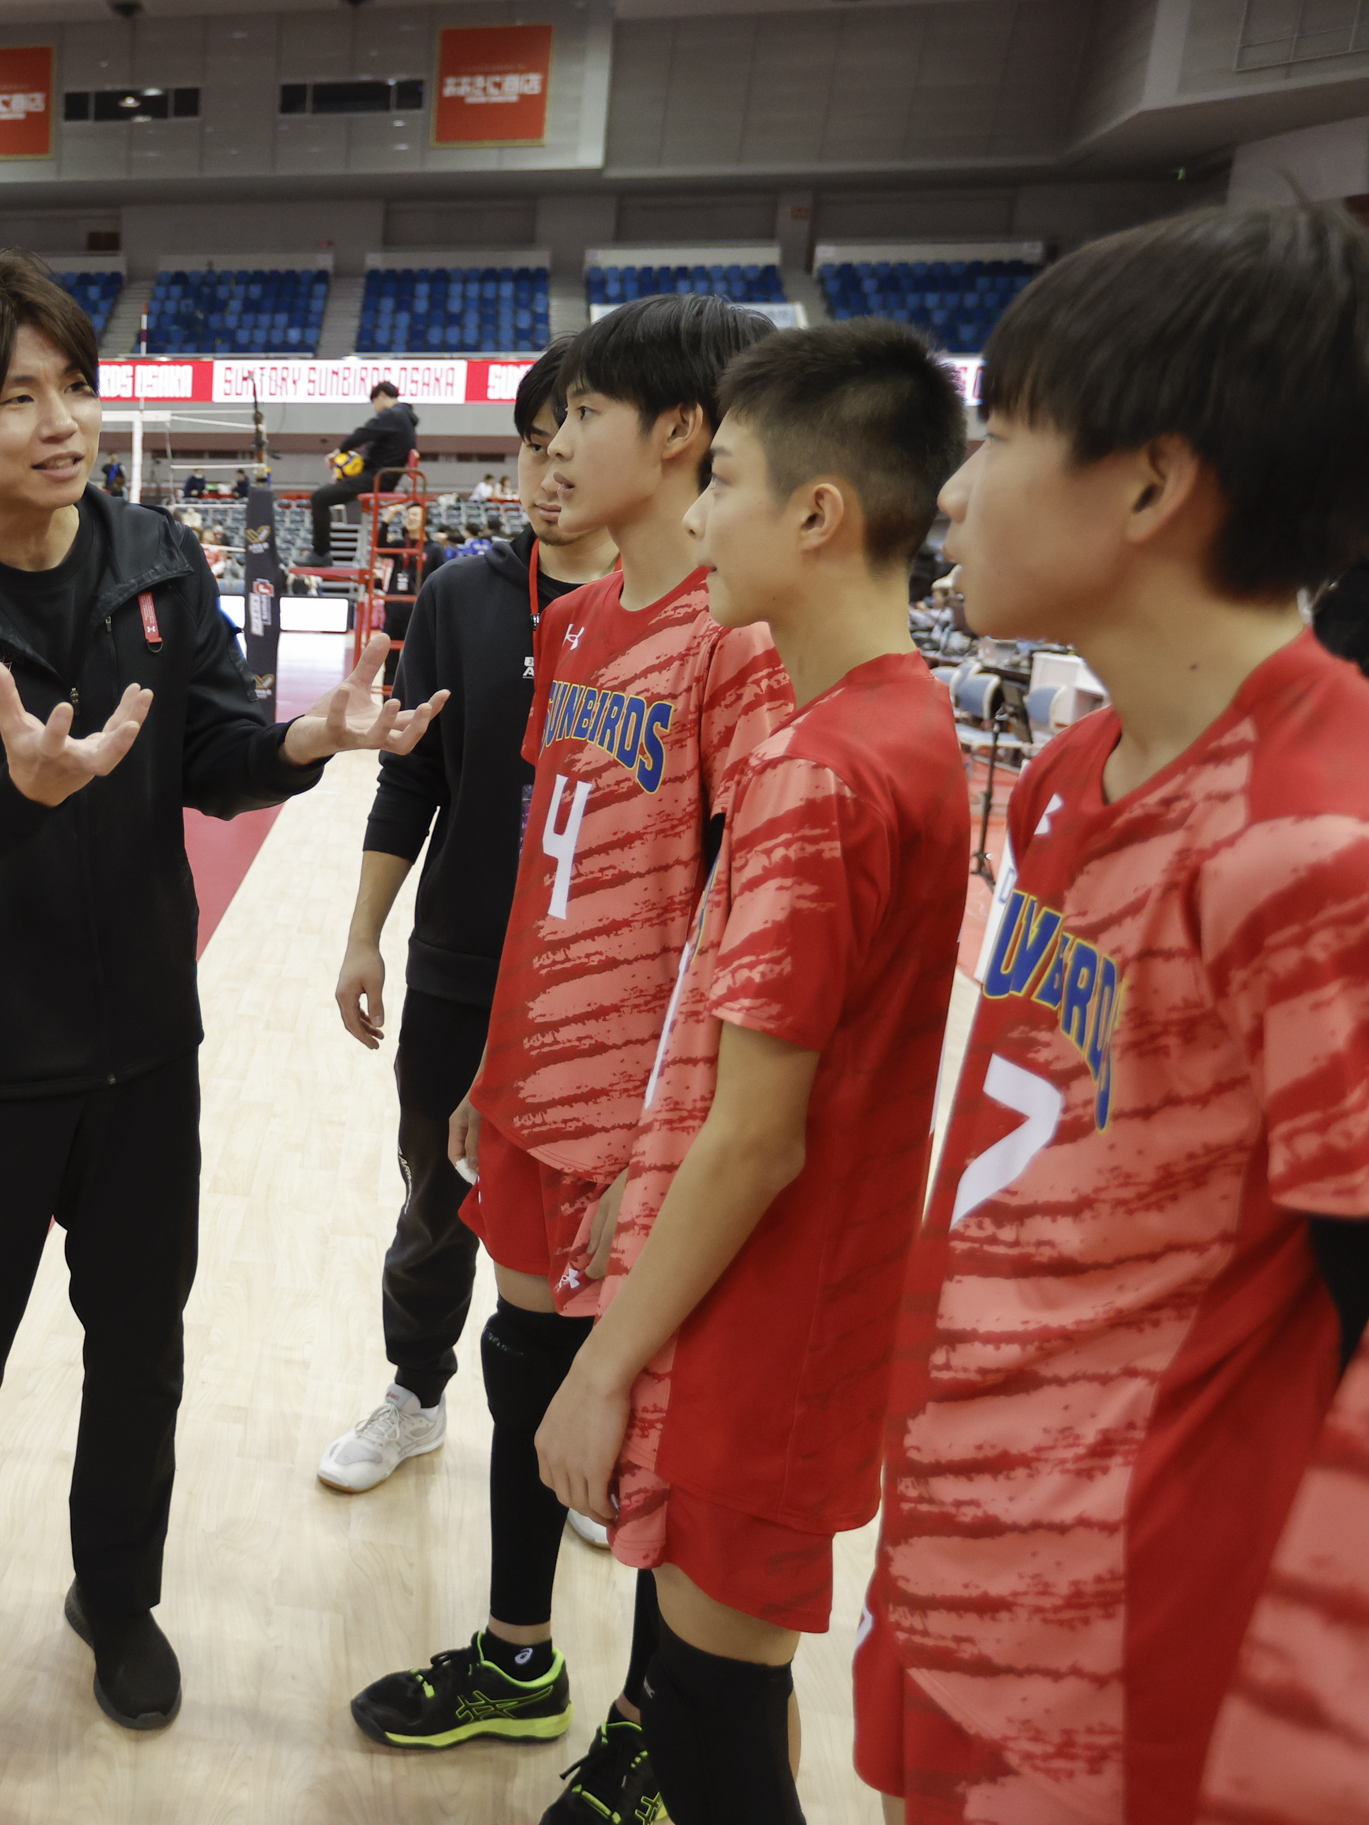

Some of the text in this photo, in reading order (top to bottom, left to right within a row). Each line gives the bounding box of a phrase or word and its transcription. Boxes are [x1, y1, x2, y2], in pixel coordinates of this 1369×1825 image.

[538, 680, 674, 794] UNBIRDS
[542, 774, 593, 920] 4
[949, 1052, 1063, 1232] 7
